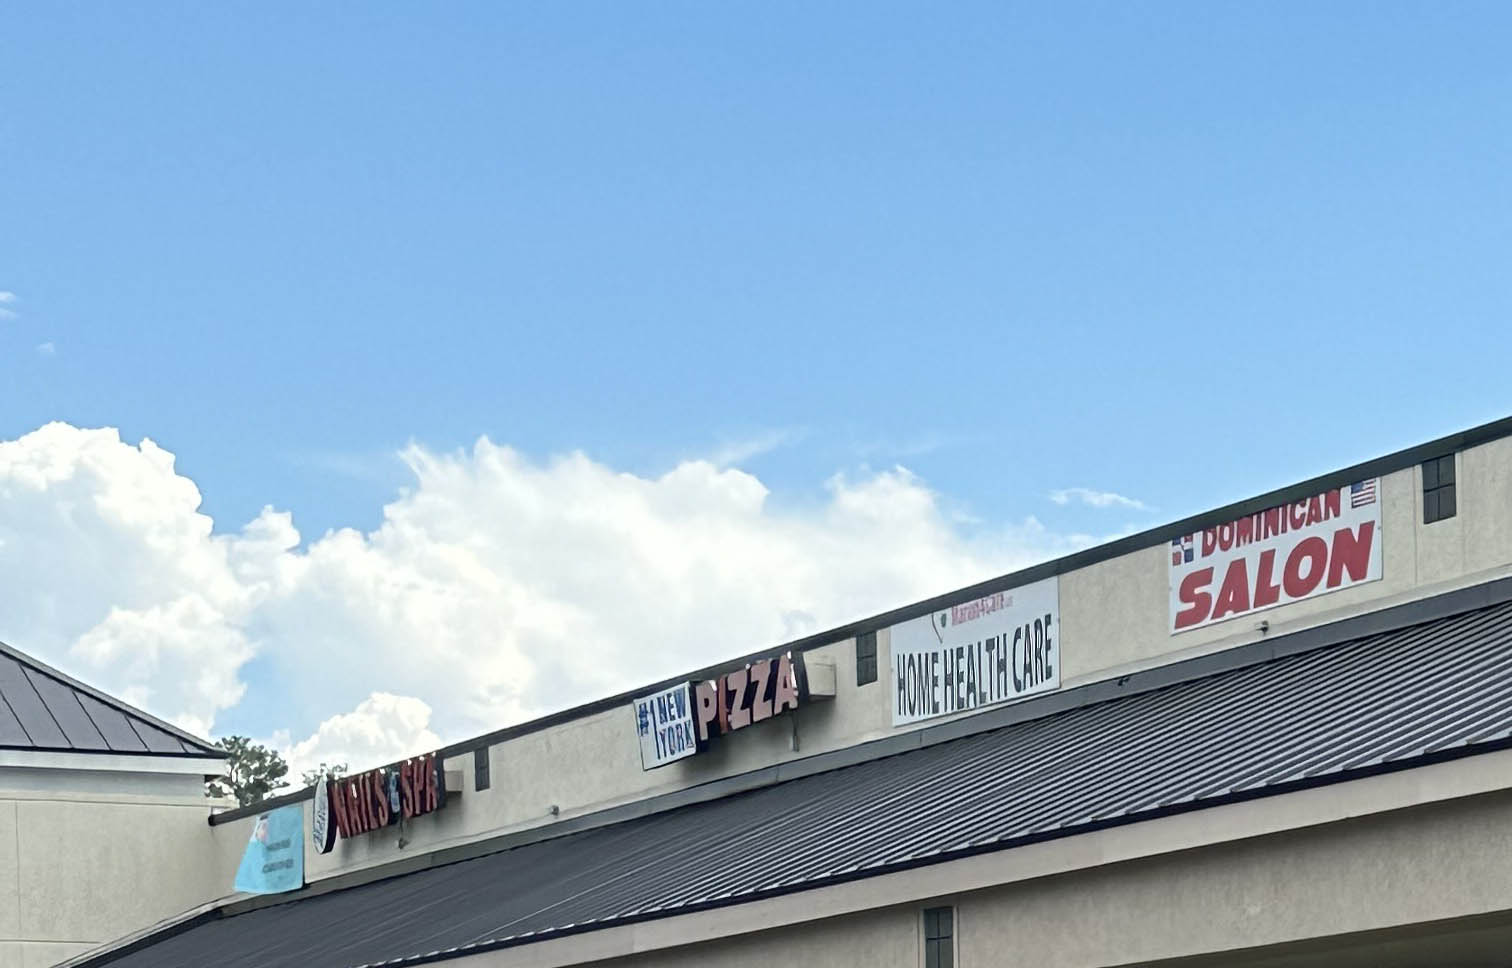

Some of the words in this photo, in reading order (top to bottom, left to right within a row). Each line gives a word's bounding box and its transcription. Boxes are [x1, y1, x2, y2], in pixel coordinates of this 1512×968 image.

[1201, 488, 1342, 557] DOMINICAN
[1174, 520, 1376, 630] SALON
[658, 688, 687, 725] NEW
[696, 650, 799, 742] PIZZA
[897, 652, 939, 716] HOME
[943, 633, 1008, 713] HEALTH
[1012, 613, 1053, 693] CARE
[658, 722, 695, 758] YORK
[331, 768, 389, 840] NAILS
[401, 751, 438, 818] SPA
